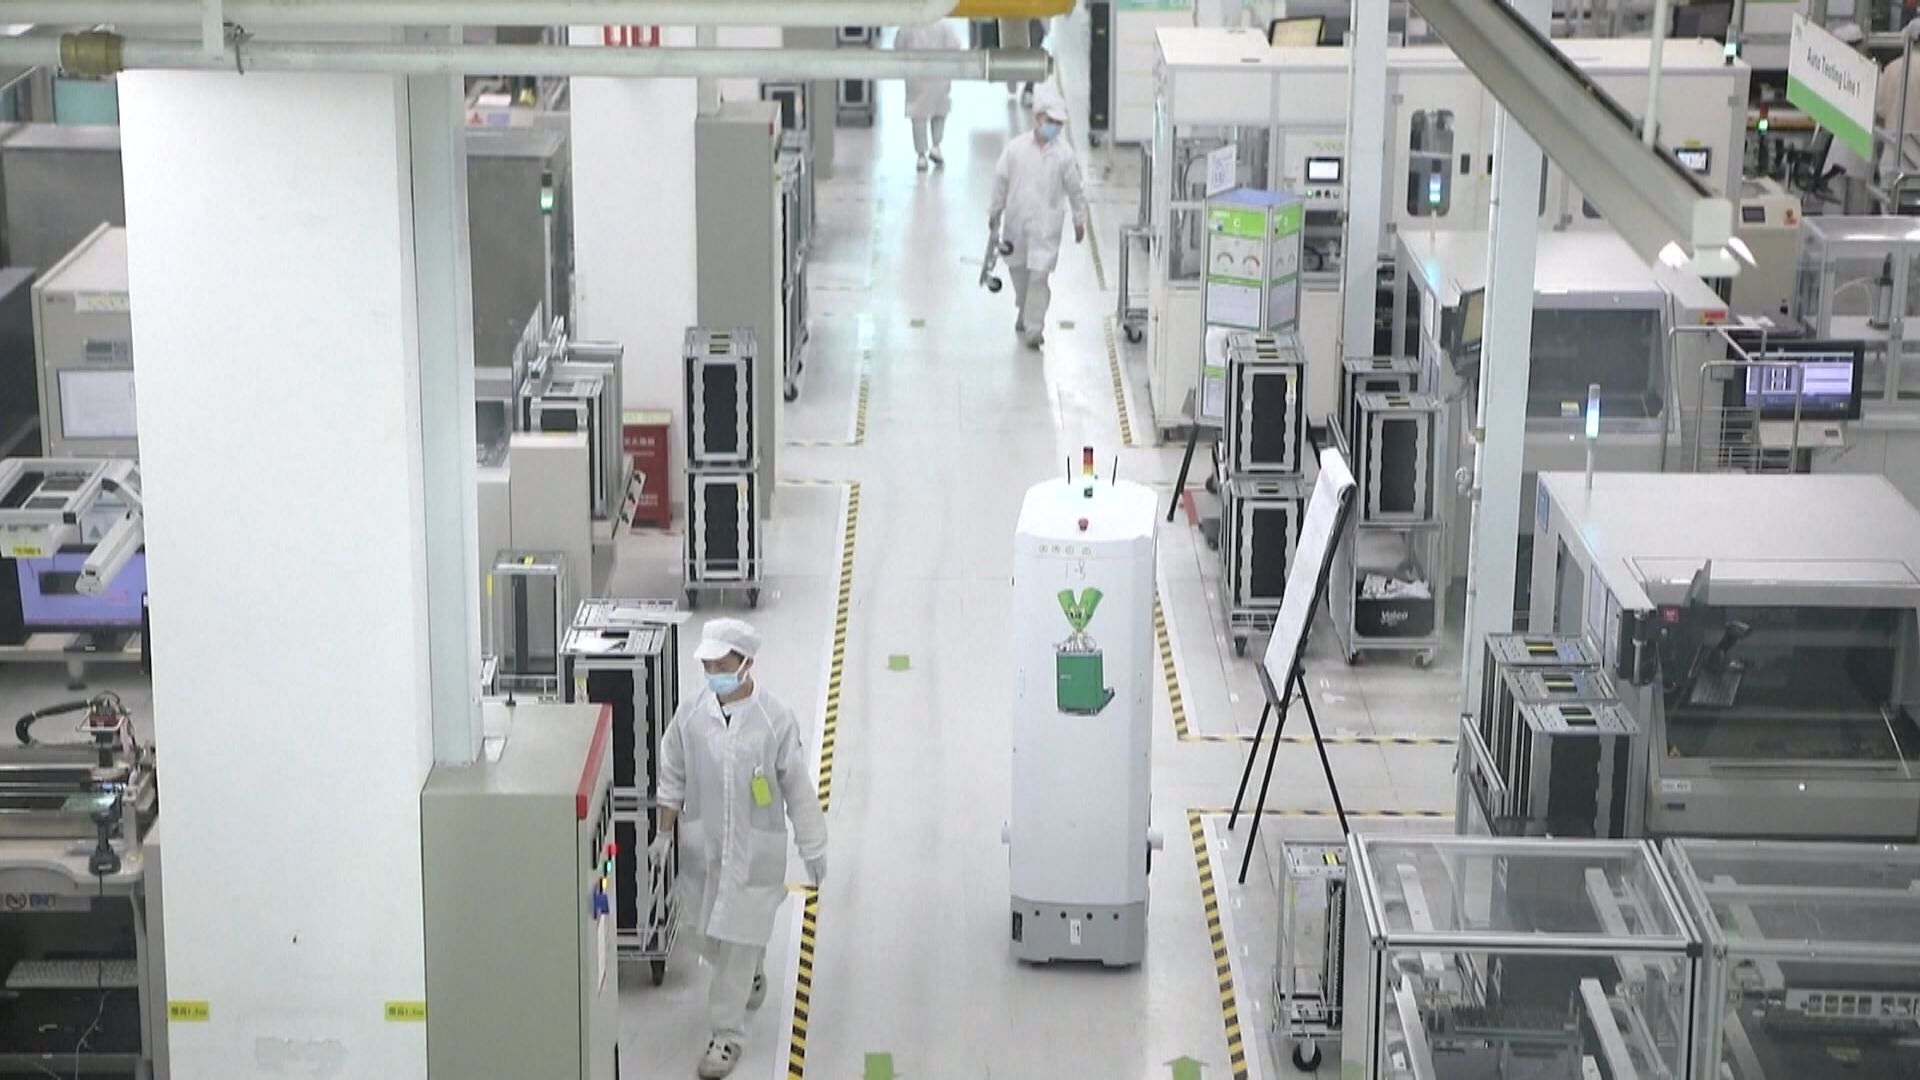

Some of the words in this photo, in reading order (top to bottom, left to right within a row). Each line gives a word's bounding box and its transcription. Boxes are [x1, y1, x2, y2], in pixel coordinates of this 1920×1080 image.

[1806, 46, 1821, 71] Auto
[1821, 53, 1843, 91] Testing
[1843, 70, 1855, 96] Line
